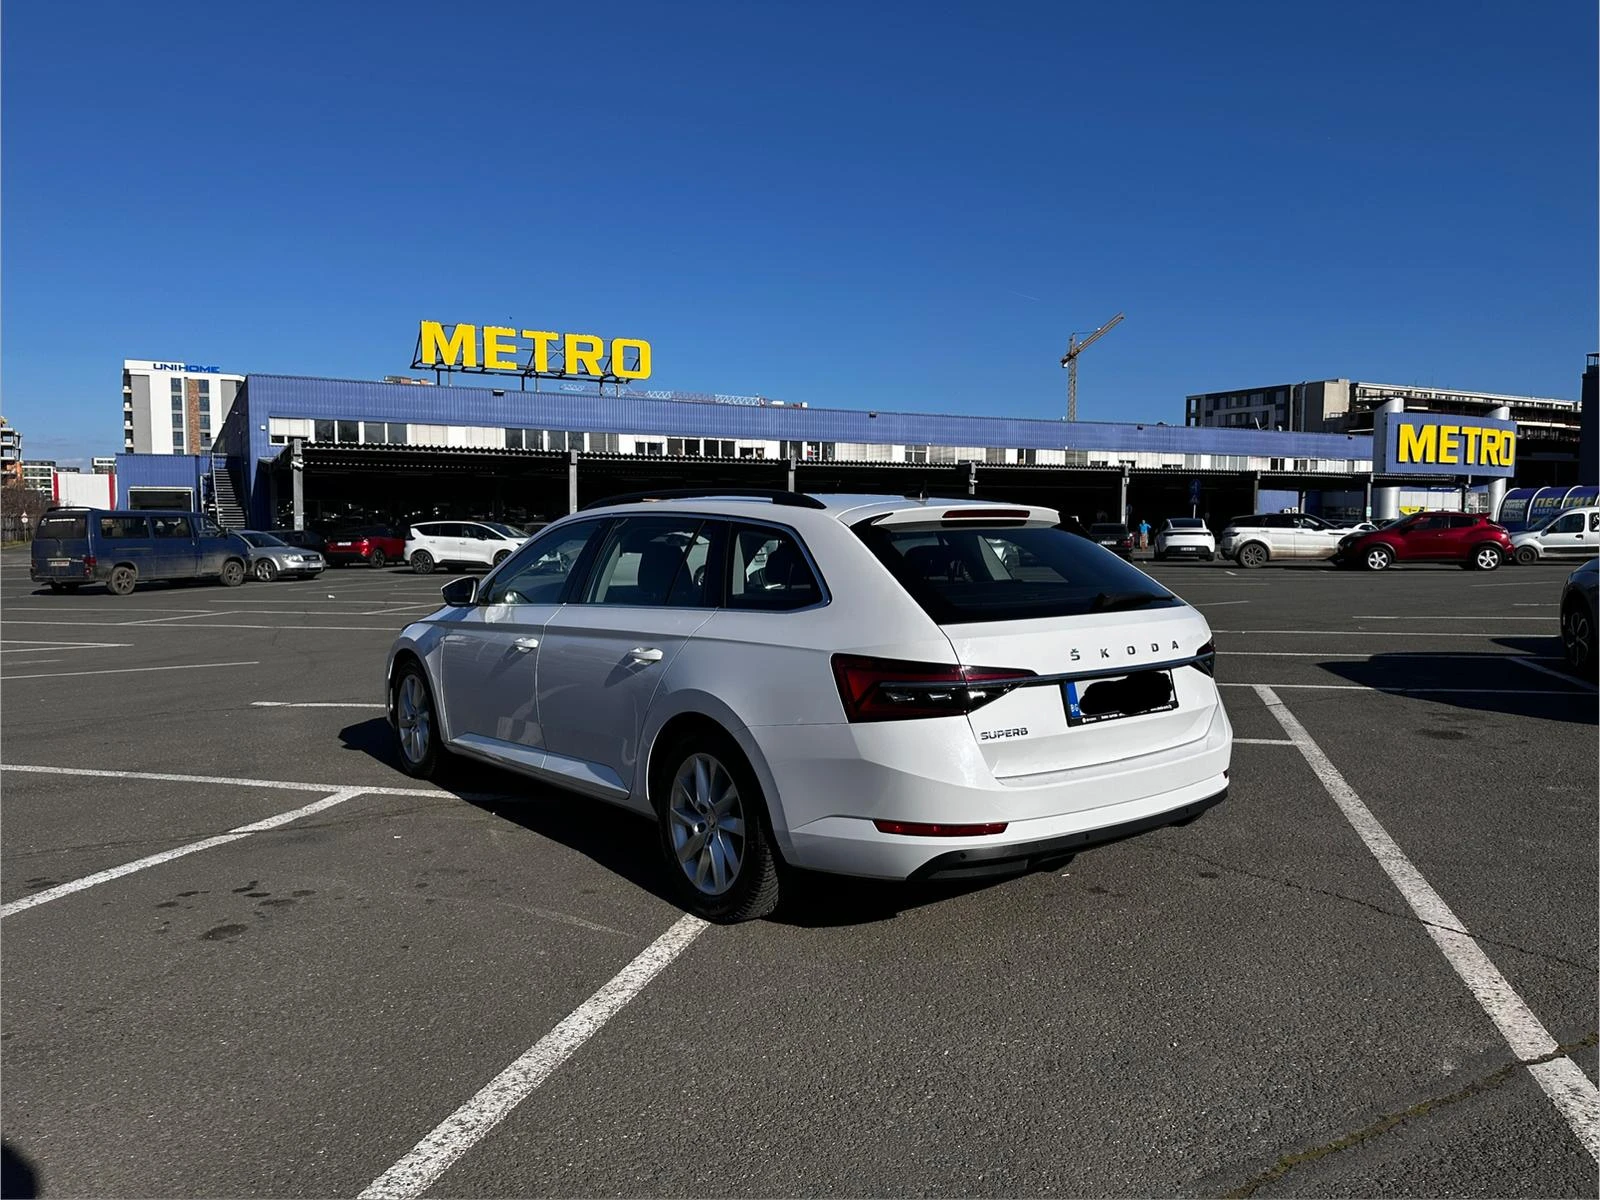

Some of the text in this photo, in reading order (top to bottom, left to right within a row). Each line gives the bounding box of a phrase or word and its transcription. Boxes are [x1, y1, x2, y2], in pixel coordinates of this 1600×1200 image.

[420, 320, 651, 380] METRO
[153, 363, 220, 373] UNIHOME
[1398, 423, 1516, 467] METRO
[1070, 640, 1179, 661] ŠKODA
[980, 727, 1029, 740] SUPERB
